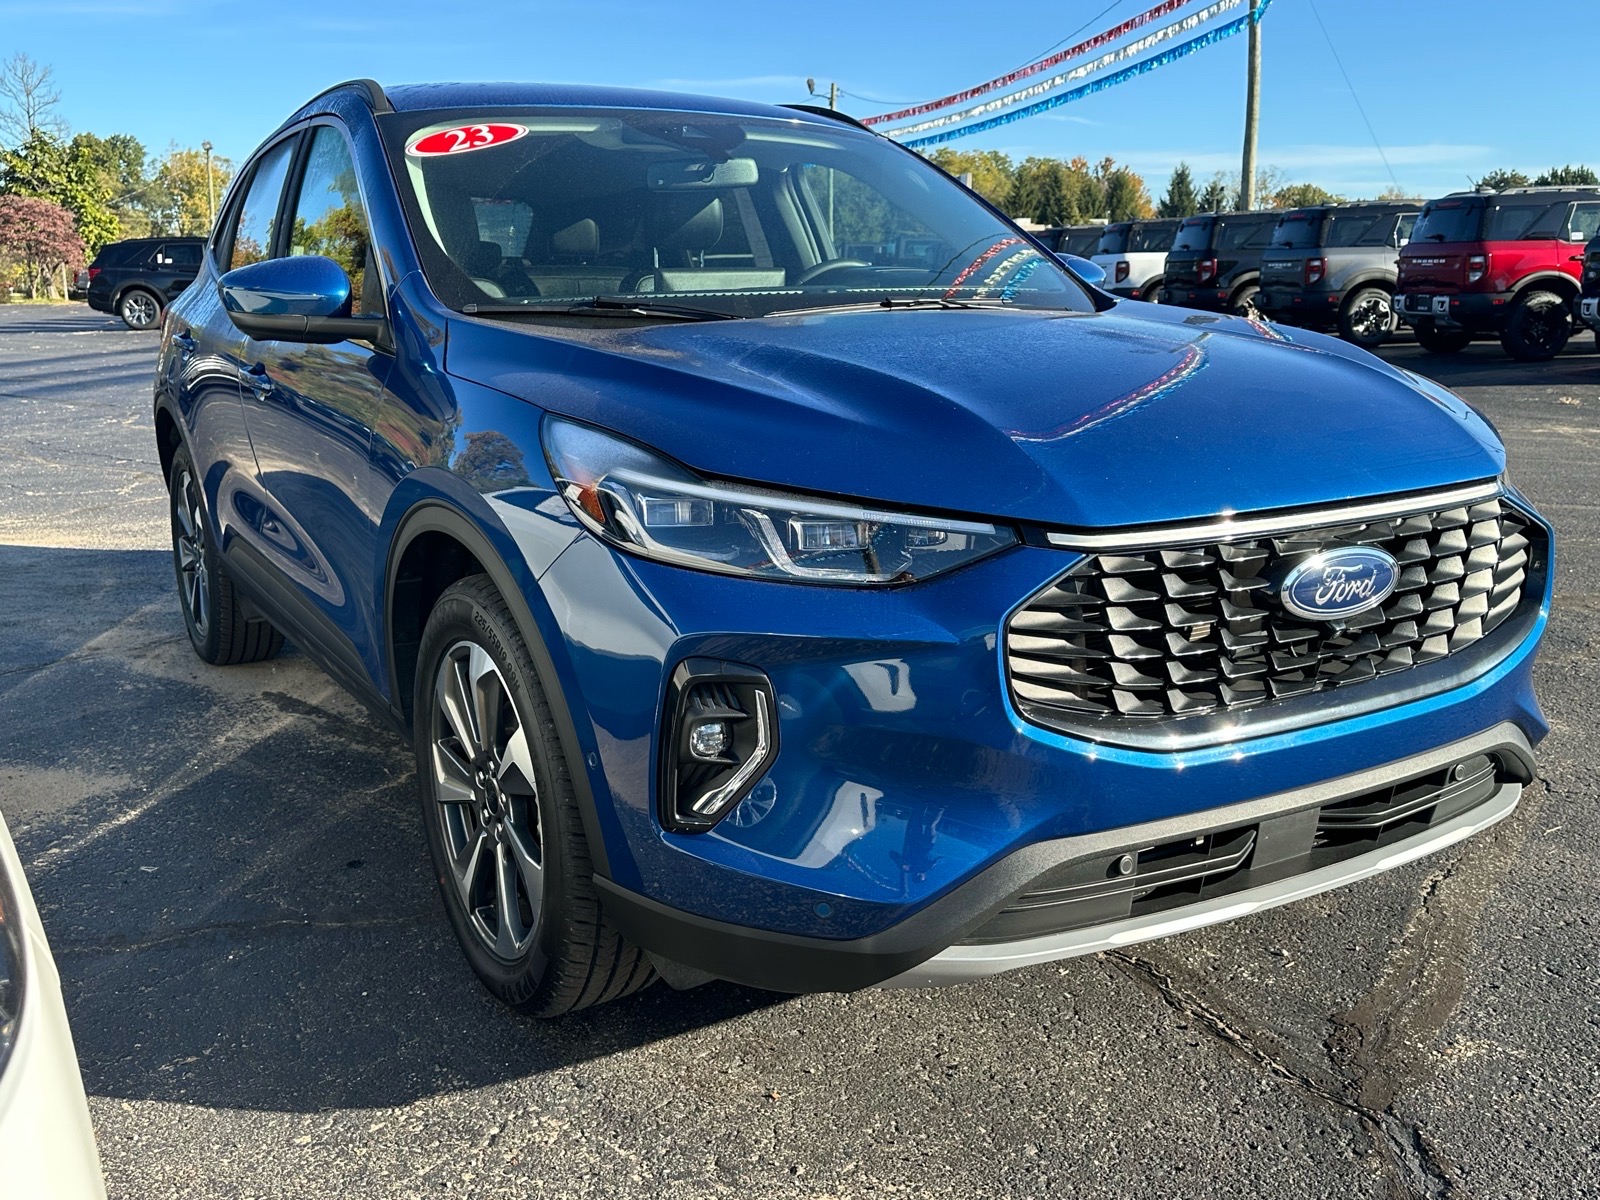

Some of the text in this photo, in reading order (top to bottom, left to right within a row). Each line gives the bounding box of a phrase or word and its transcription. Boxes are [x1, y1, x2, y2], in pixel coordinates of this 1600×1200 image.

[445, 125, 494, 152] 23
[1315, 564, 1378, 606] Ford
[474, 611, 508, 662] 225/55R19
